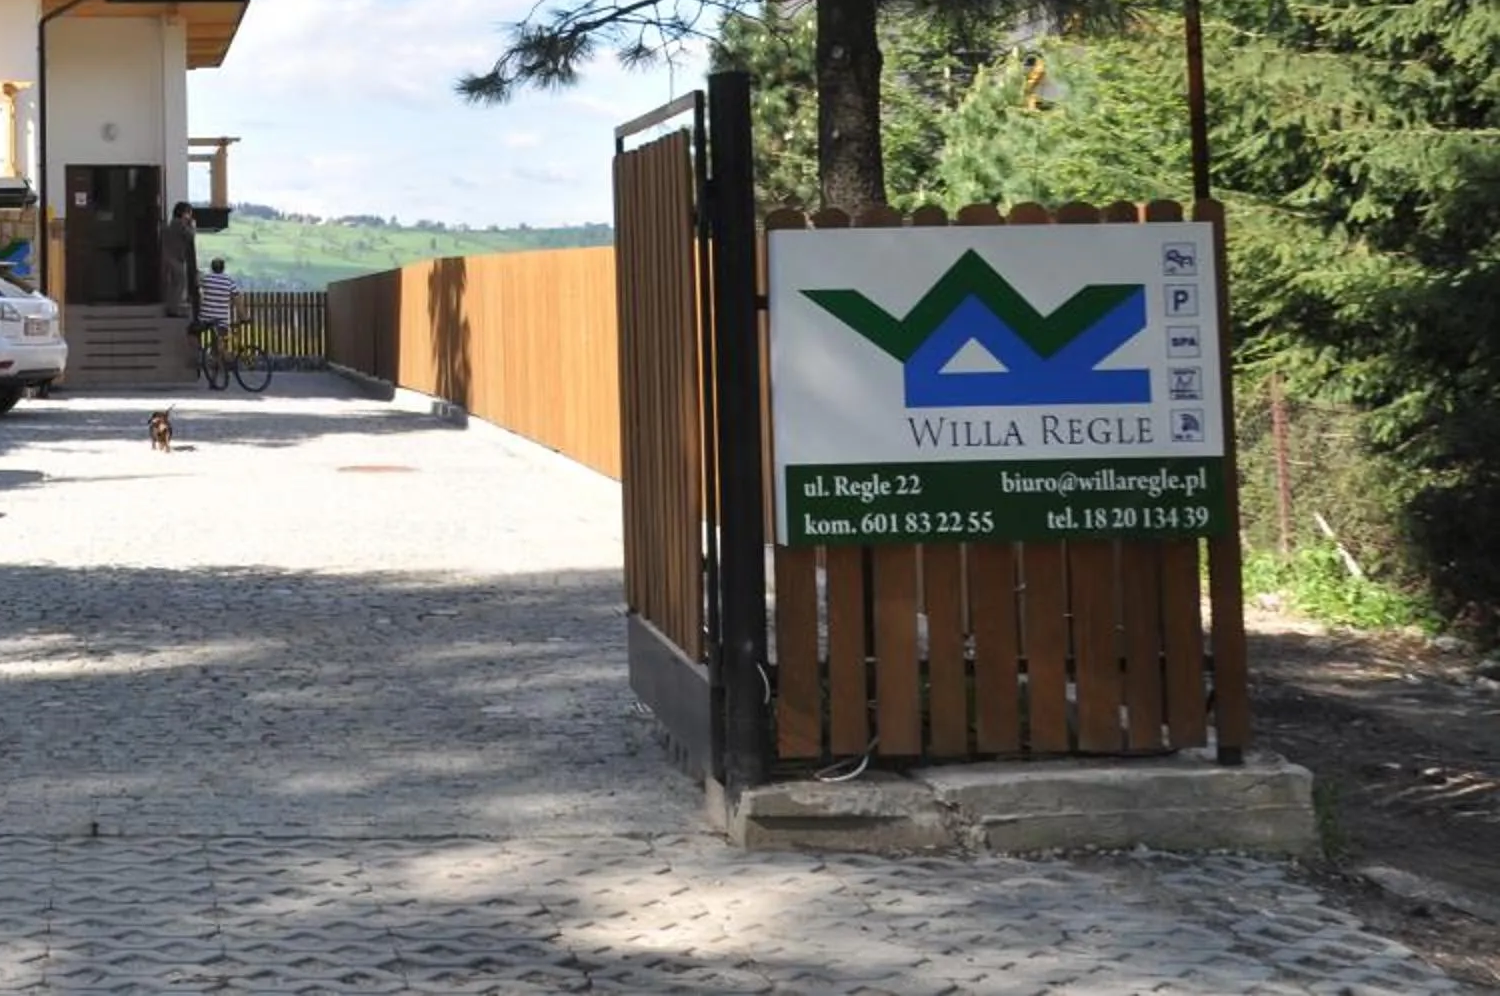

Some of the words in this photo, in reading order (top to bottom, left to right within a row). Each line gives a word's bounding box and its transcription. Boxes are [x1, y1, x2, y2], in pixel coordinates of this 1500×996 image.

[1173, 289, 1189, 312] P
[908, 416, 1026, 448] WILLA
[1041, 415, 1154, 446] REGLE
[803, 475, 830, 497] ul.
[834, 473, 891, 503] Regle
[895, 474, 922, 495] 22
[1001, 466, 1207, 498] biuro@willaregle.pl
[804, 513, 857, 535] kom.
[861, 513, 899, 534] 601
[904, 511, 931, 533] 83
[936, 511, 963, 533] 22
[967, 510, 995, 533] 55
[1046, 506, 1079, 529] tel.
[1083, 507, 1108, 529] 18
[1111, 507, 1137, 528] 20
[1142, 507, 1179, 528] 134
[1183, 505, 1209, 527] 39
